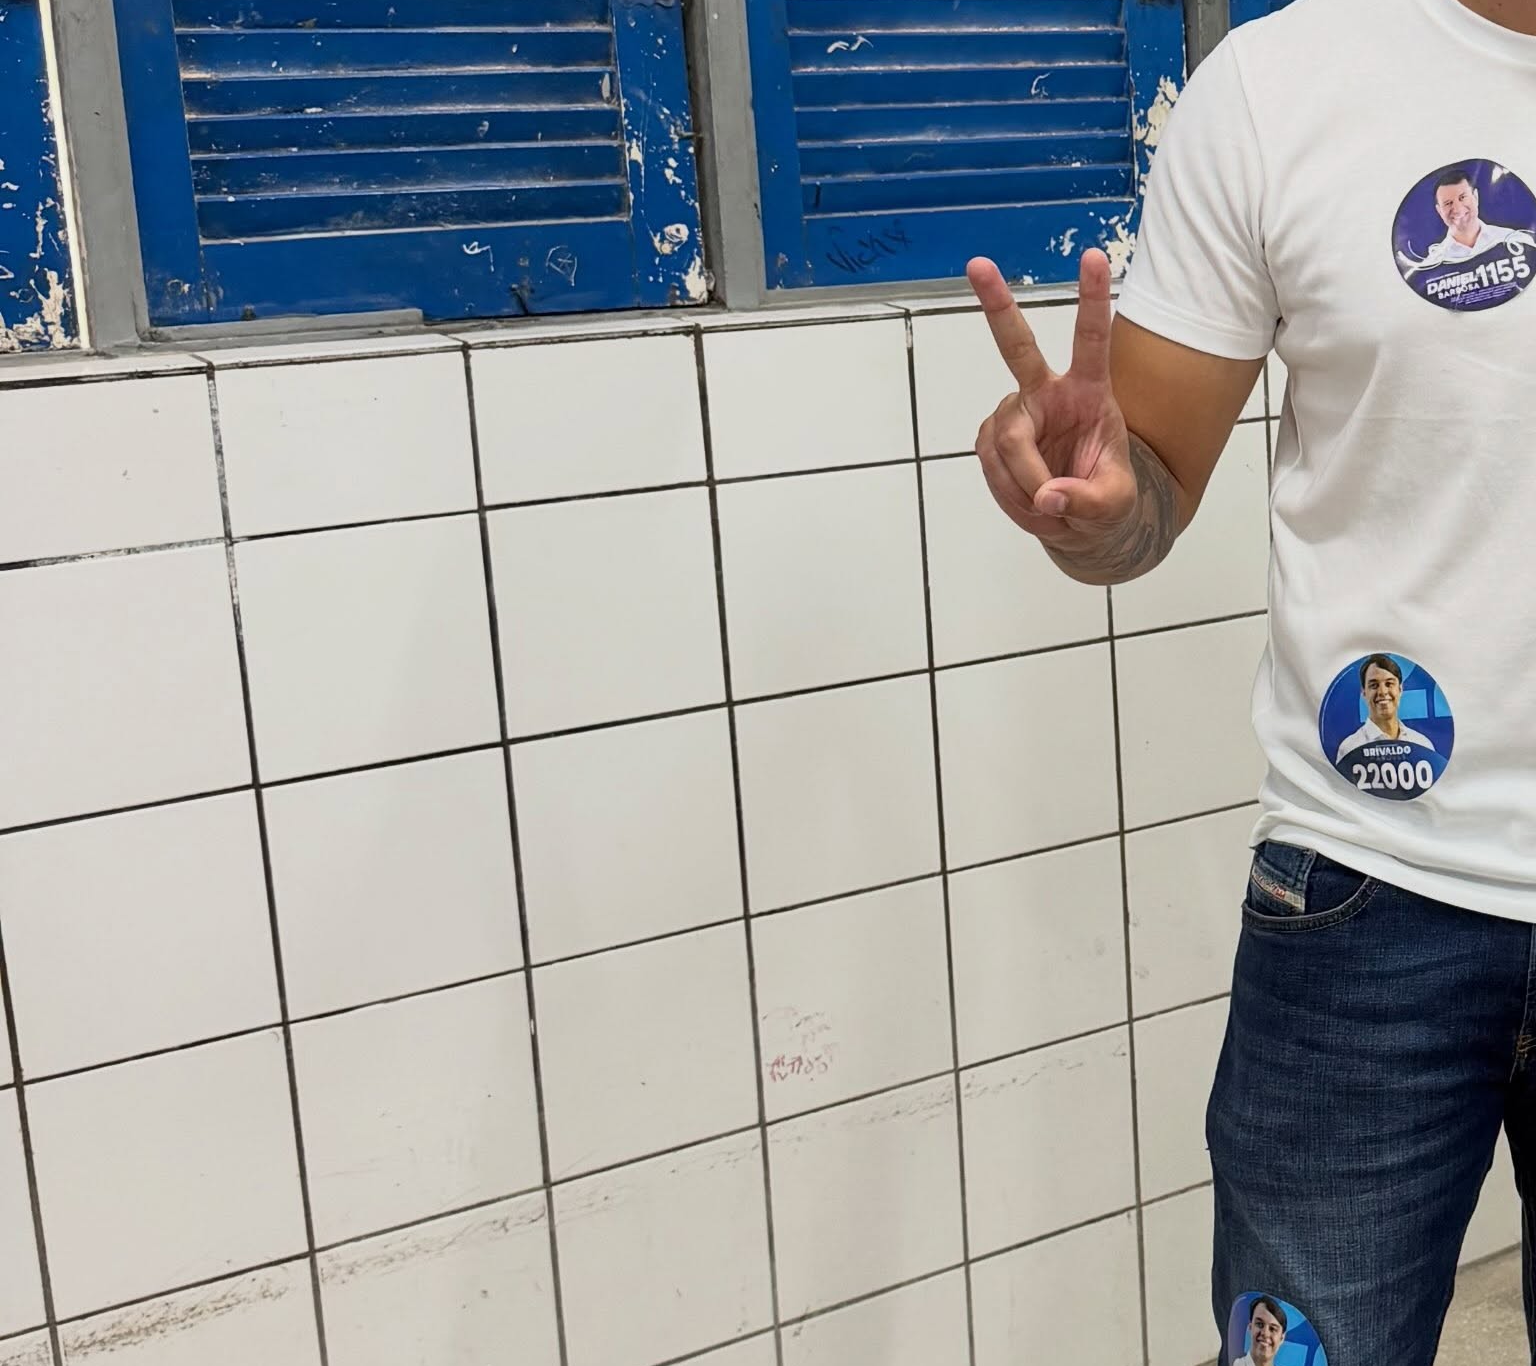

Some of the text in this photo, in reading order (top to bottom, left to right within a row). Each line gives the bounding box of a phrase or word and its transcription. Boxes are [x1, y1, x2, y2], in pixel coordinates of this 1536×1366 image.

[1427, 271, 1478, 295] DANIEL
[1476, 255, 1531, 287] 1155
[1363, 745, 1412, 757] BRIVALDO
[1353, 760, 1433, 790] 22000
